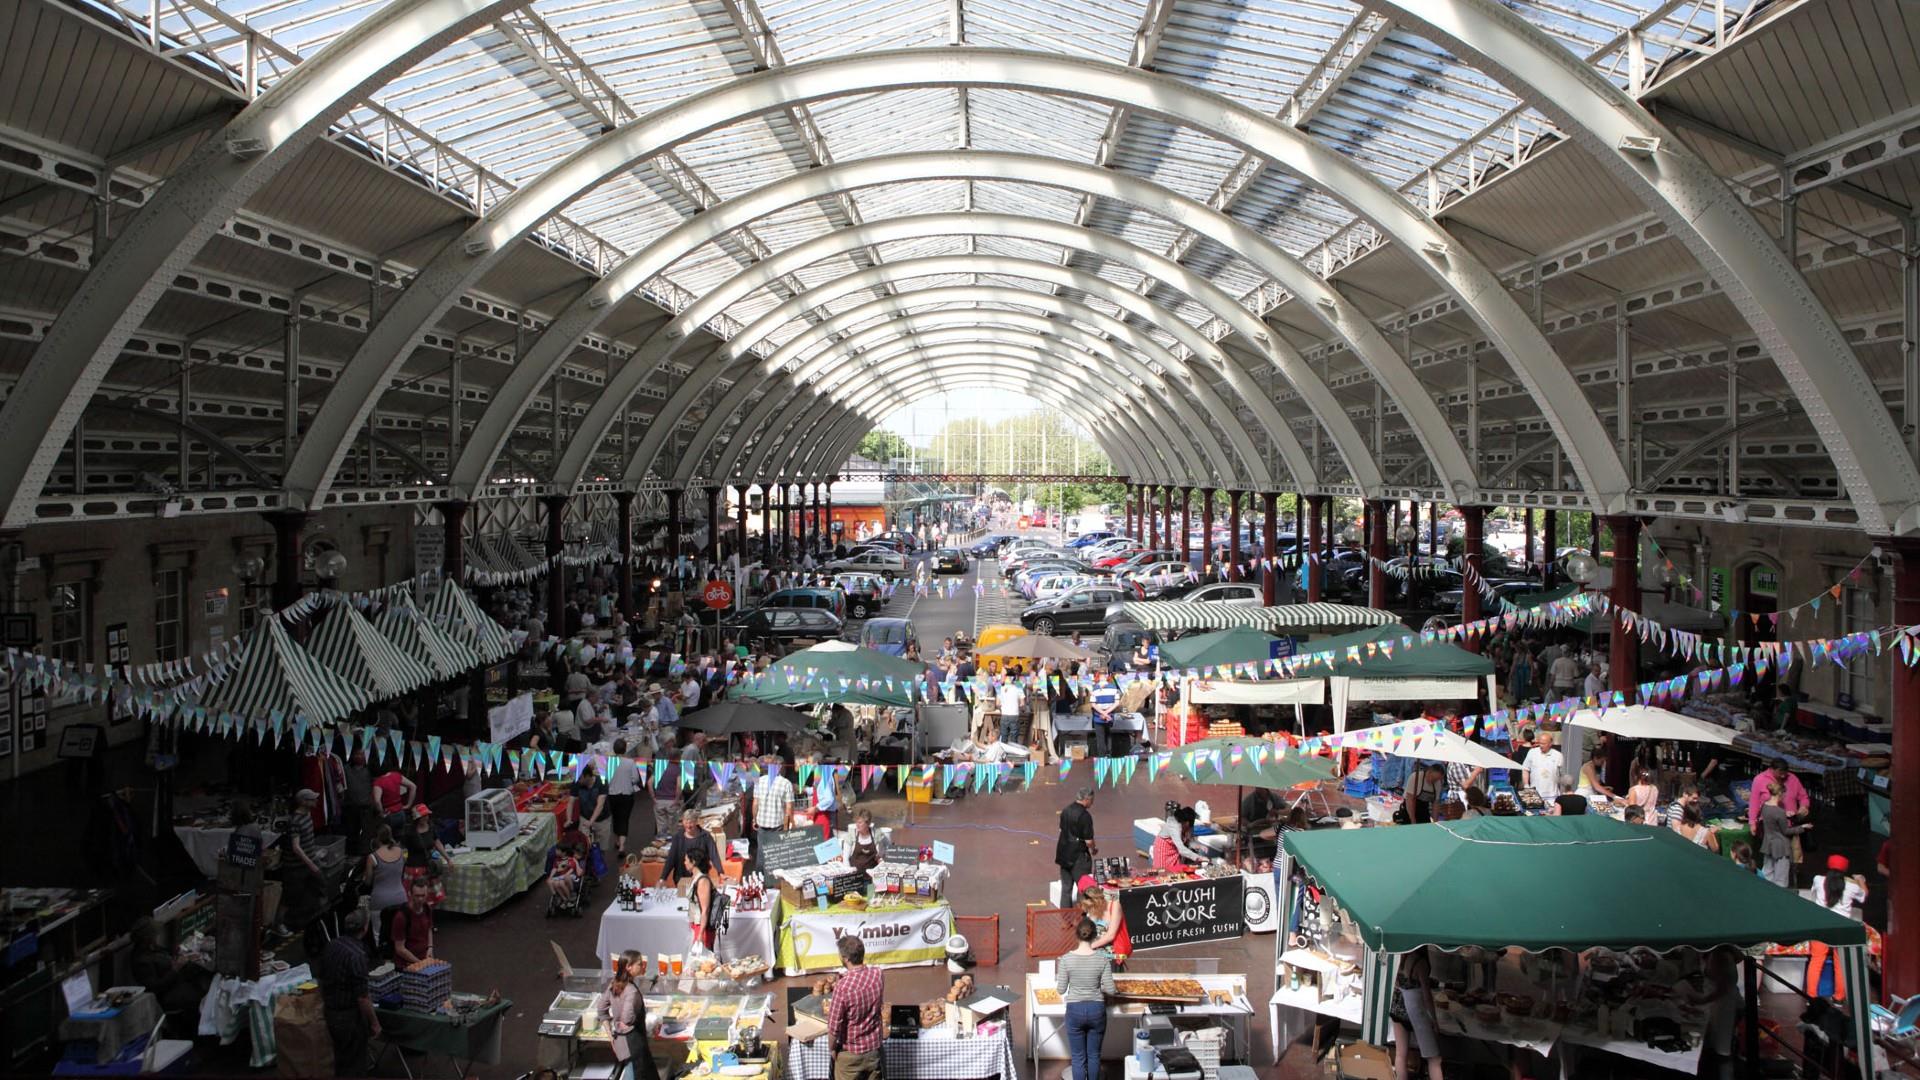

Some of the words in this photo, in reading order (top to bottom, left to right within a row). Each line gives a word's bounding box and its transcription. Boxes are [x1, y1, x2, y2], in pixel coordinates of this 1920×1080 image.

[1145, 892, 1172, 909] A.S.
[1176, 887, 1216, 905] SUSHI
[1146, 911, 1162, 927] &
[1165, 904, 1217, 924] MORE
[1130, 930, 1173, 944] ELICIOUS
[1176, 927, 1205, 939] FRESH
[1212, 922, 1239, 934] SUSHI
